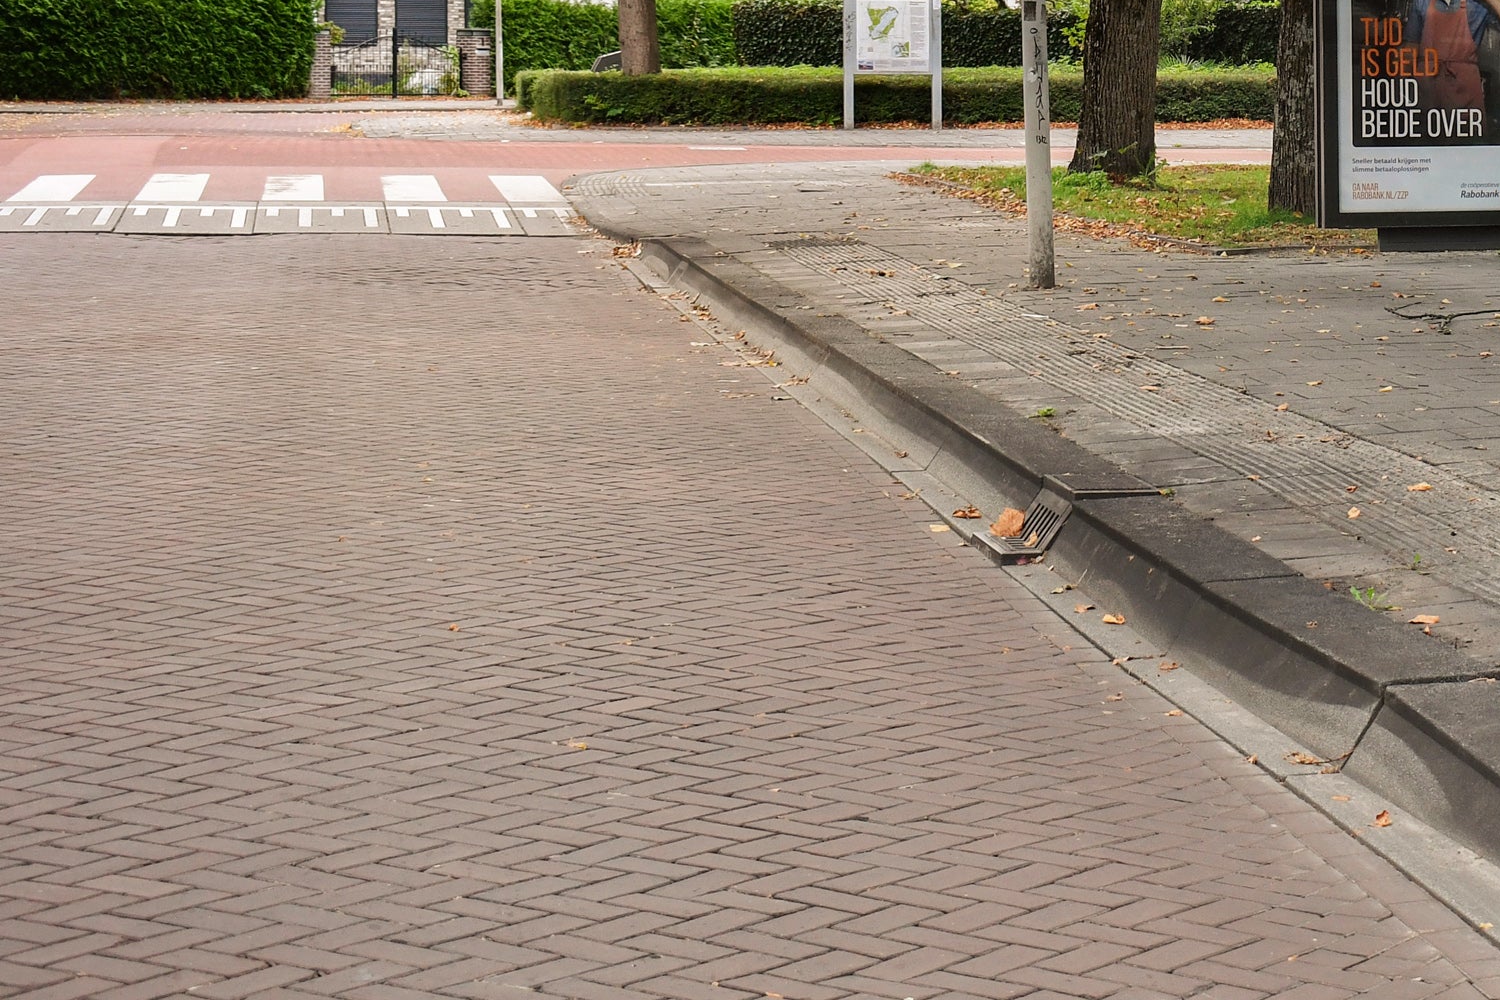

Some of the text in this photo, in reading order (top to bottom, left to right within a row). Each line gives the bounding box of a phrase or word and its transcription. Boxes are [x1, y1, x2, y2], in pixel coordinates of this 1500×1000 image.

[1360, 17, 1403, 46] TIJD
[1361, 47, 1439, 77] IS GELD
[1361, 78, 1419, 108] HOUD
[1361, 108, 1483, 138] BEIDE OVER
[1398, 157, 1419, 165] krijgen
[1352, 182, 1379, 191] GA NAAR
[1460, 189, 1500, 198] Rabobank
